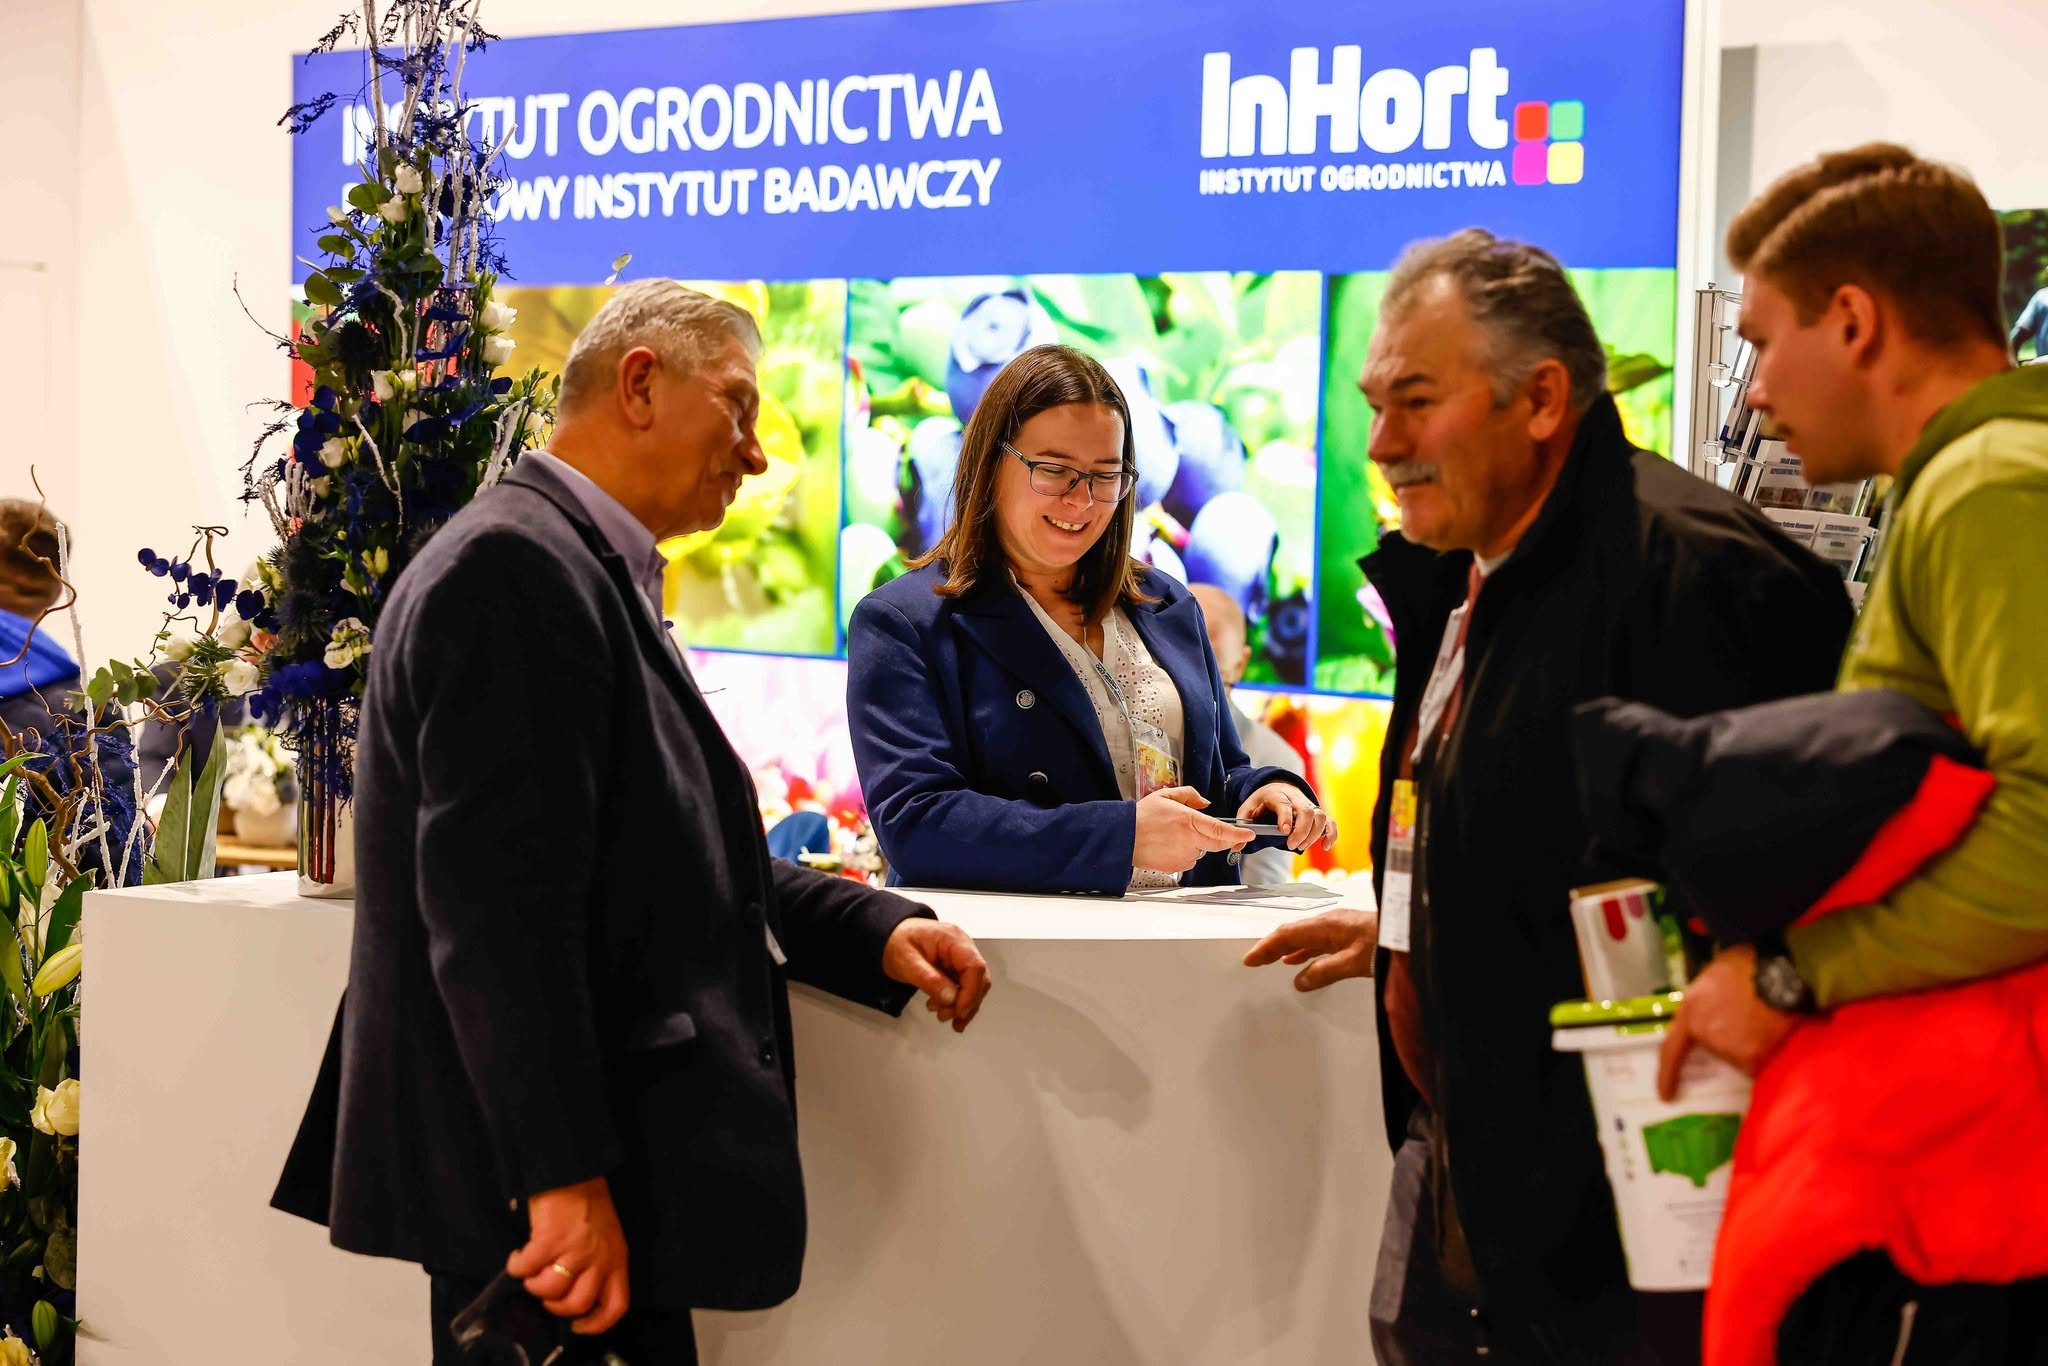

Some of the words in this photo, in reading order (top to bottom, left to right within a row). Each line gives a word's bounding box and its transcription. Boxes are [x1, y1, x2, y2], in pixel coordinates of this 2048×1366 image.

[342, 92, 570, 167] INTUT
[577, 67, 1003, 156] OGRODNICTWA
[1200, 44, 1509, 158] InHort
[574, 168, 758, 220] INSTYTUT
[771, 157, 1002, 214] BADAWCZY
[1199, 165, 1317, 196] INSTYTUT
[1320, 160, 1507, 193] OGRODNICTWA
